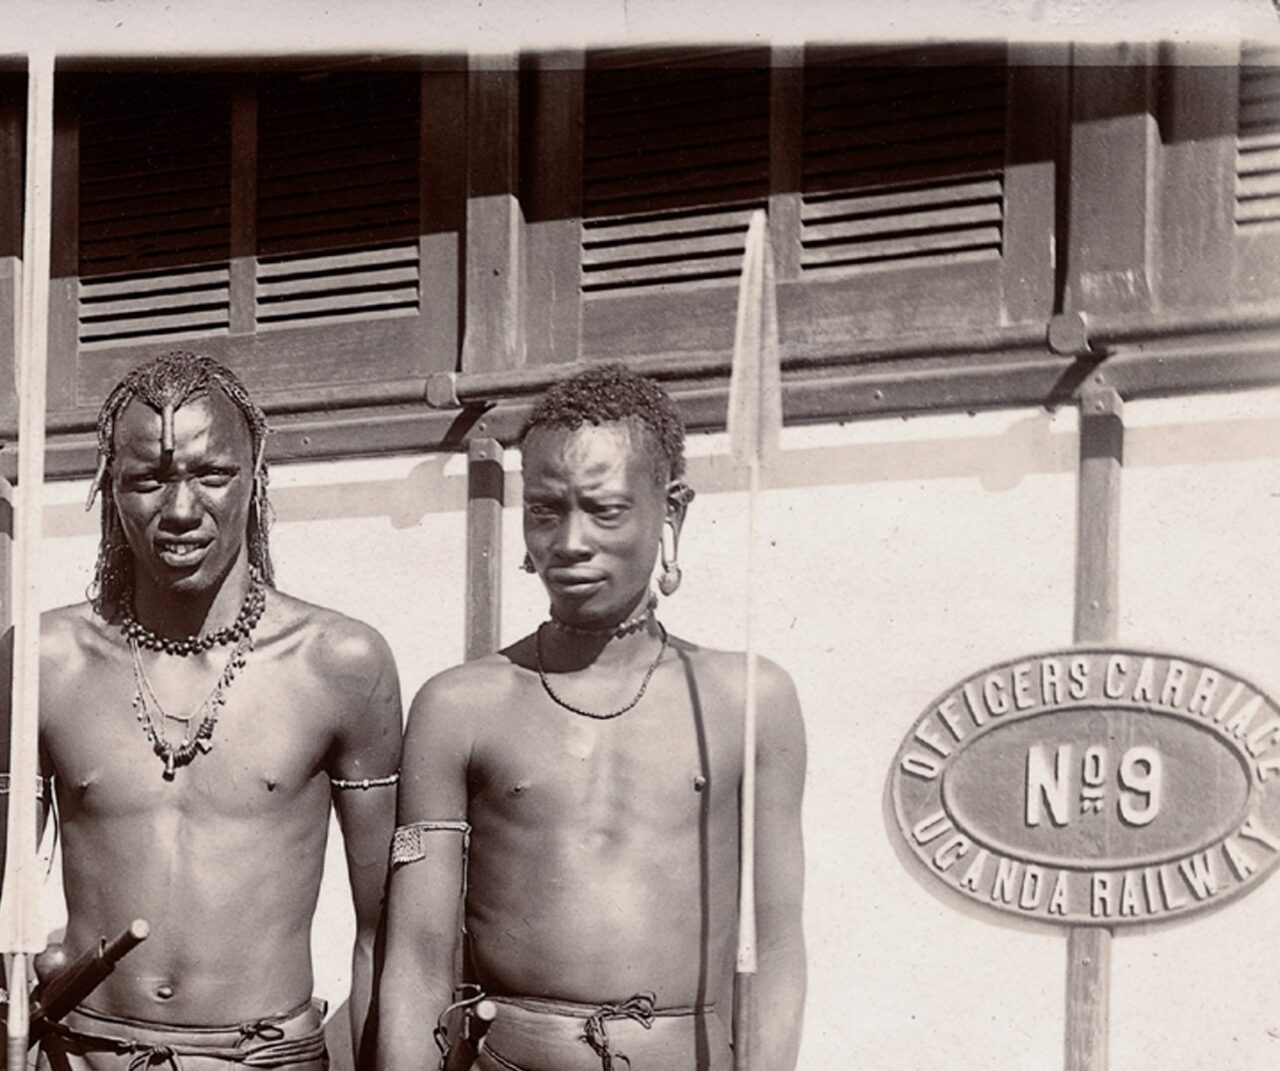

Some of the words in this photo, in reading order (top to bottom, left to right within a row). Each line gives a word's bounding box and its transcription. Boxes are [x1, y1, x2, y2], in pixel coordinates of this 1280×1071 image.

[901, 658, 1088, 781] OFFICERS
[912, 811, 1069, 916] UGANDA
[1091, 816, 1280, 918] RAILWAY
